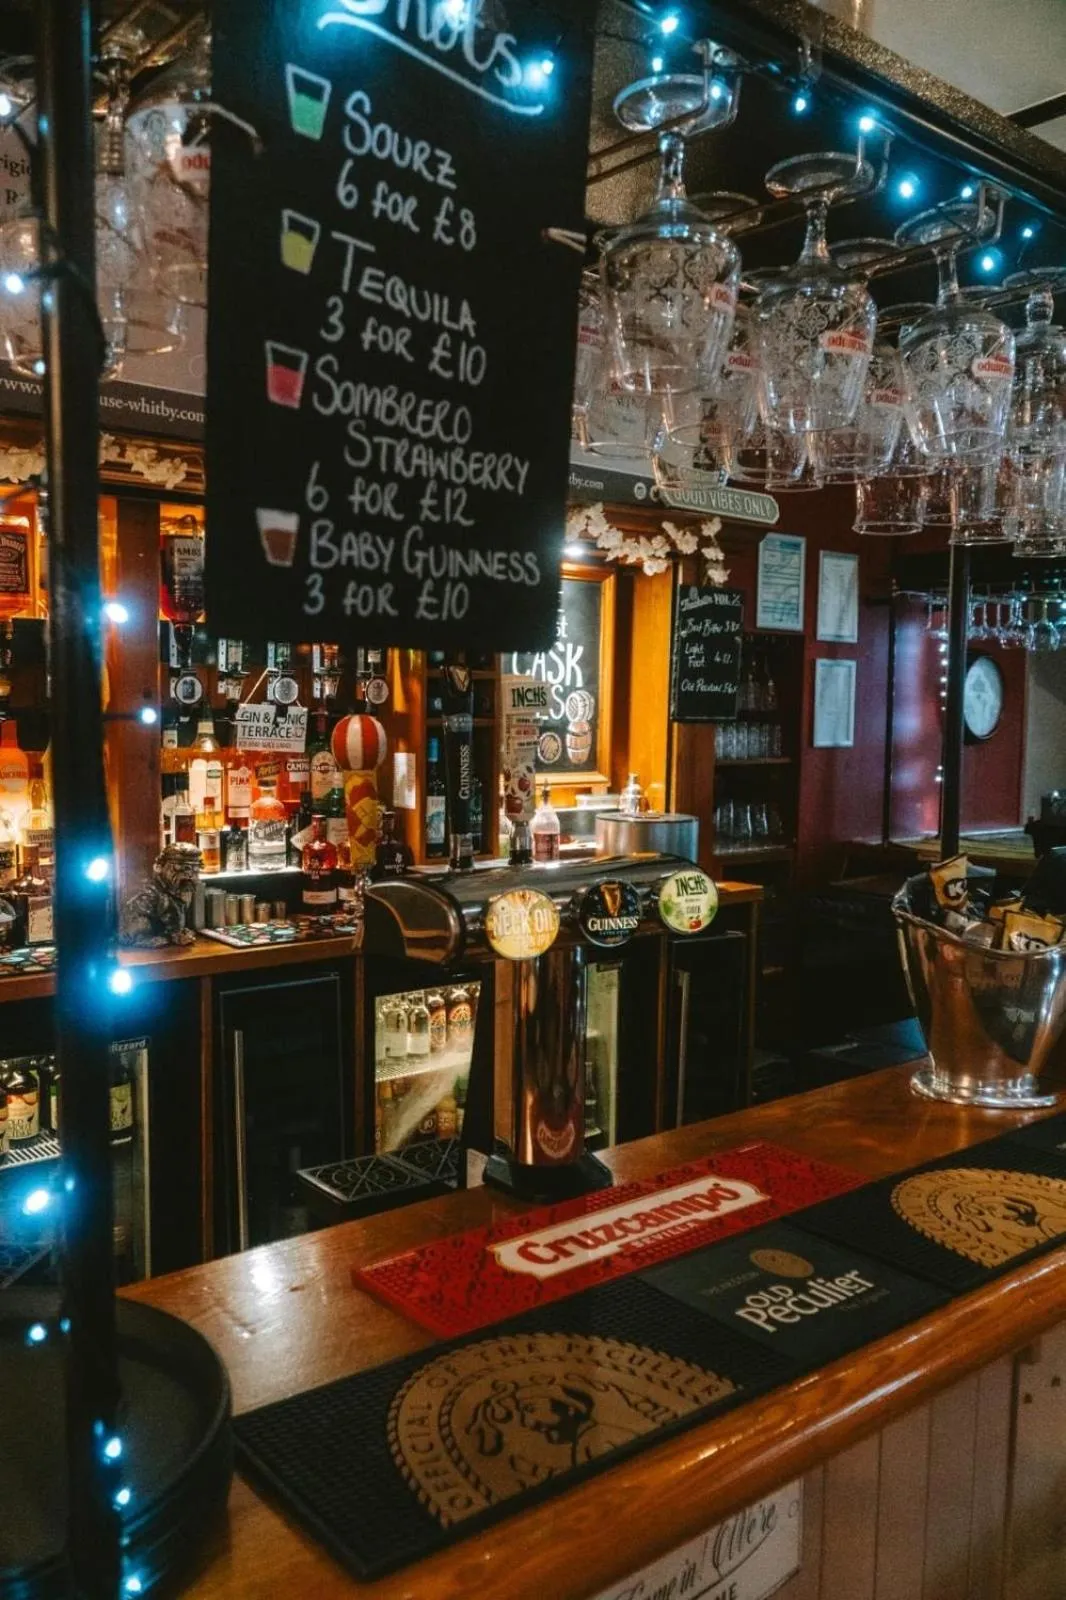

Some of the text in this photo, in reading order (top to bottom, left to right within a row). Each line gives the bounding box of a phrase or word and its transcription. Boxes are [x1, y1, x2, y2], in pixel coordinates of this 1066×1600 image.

[342, 0, 522, 87] hots
[344, 90, 457, 190] SOURZ
[336, 159, 358, 209] 6
[433, 197, 478, 251] £8
[331, 230, 478, 338] TEQUILA
[320, 296, 346, 343] 3
[428, 333, 487, 387] £10
[312, 354, 472, 444] SOMBRERO
[344, 419, 530, 495] STRAWBERRY
[305, 461, 329, 512] 6
[420, 482, 475, 526] £12
[709, 491, 741, 511] VIBES
[744, 497, 772, 517] ONLY
[310, 518, 541, 586] BABY GUINNESS
[303, 574, 325, 615] 3
[416, 581, 470, 620] £10
[512, 642, 584, 688] CASK
[240, 710, 260, 724] GIN
[263, 711, 271, 724] &
[241, 725, 292, 739] TERRACE
[459, 744, 470, 800] GUINNESS
[493, 907, 553, 937] NECK OIL
[587, 914, 638, 932] GUINNESS
[517, 1181, 742, 1266] Cruzcampo
[746, 1285, 794, 1309] OLD
